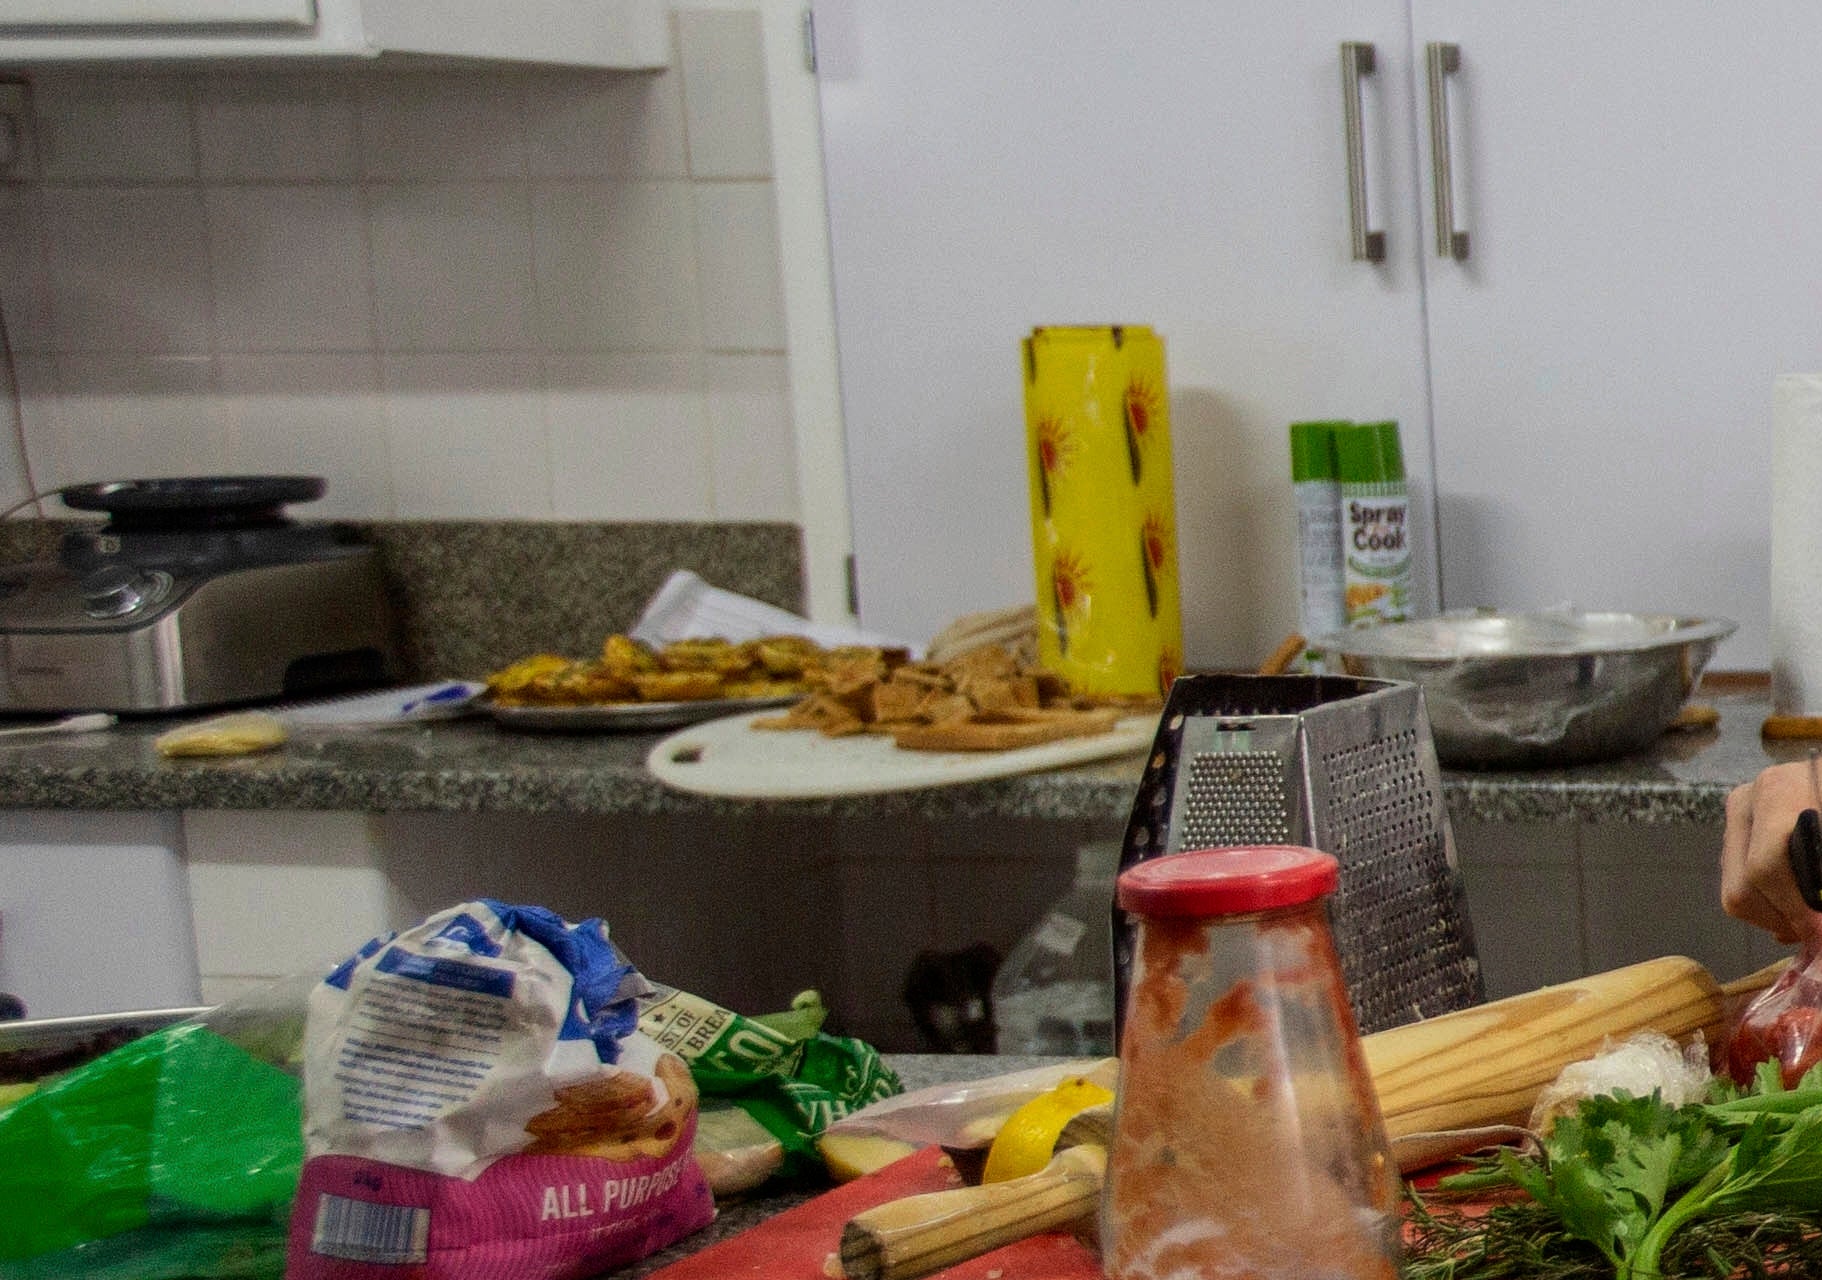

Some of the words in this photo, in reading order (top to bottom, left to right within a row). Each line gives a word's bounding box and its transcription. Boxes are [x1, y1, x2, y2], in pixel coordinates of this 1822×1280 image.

[1351, 501, 1405, 526] Spray
[1354, 527, 1405, 550] Cook
[541, 1182, 595, 1221] ALL
[602, 1163, 686, 1214] PURPOSE
